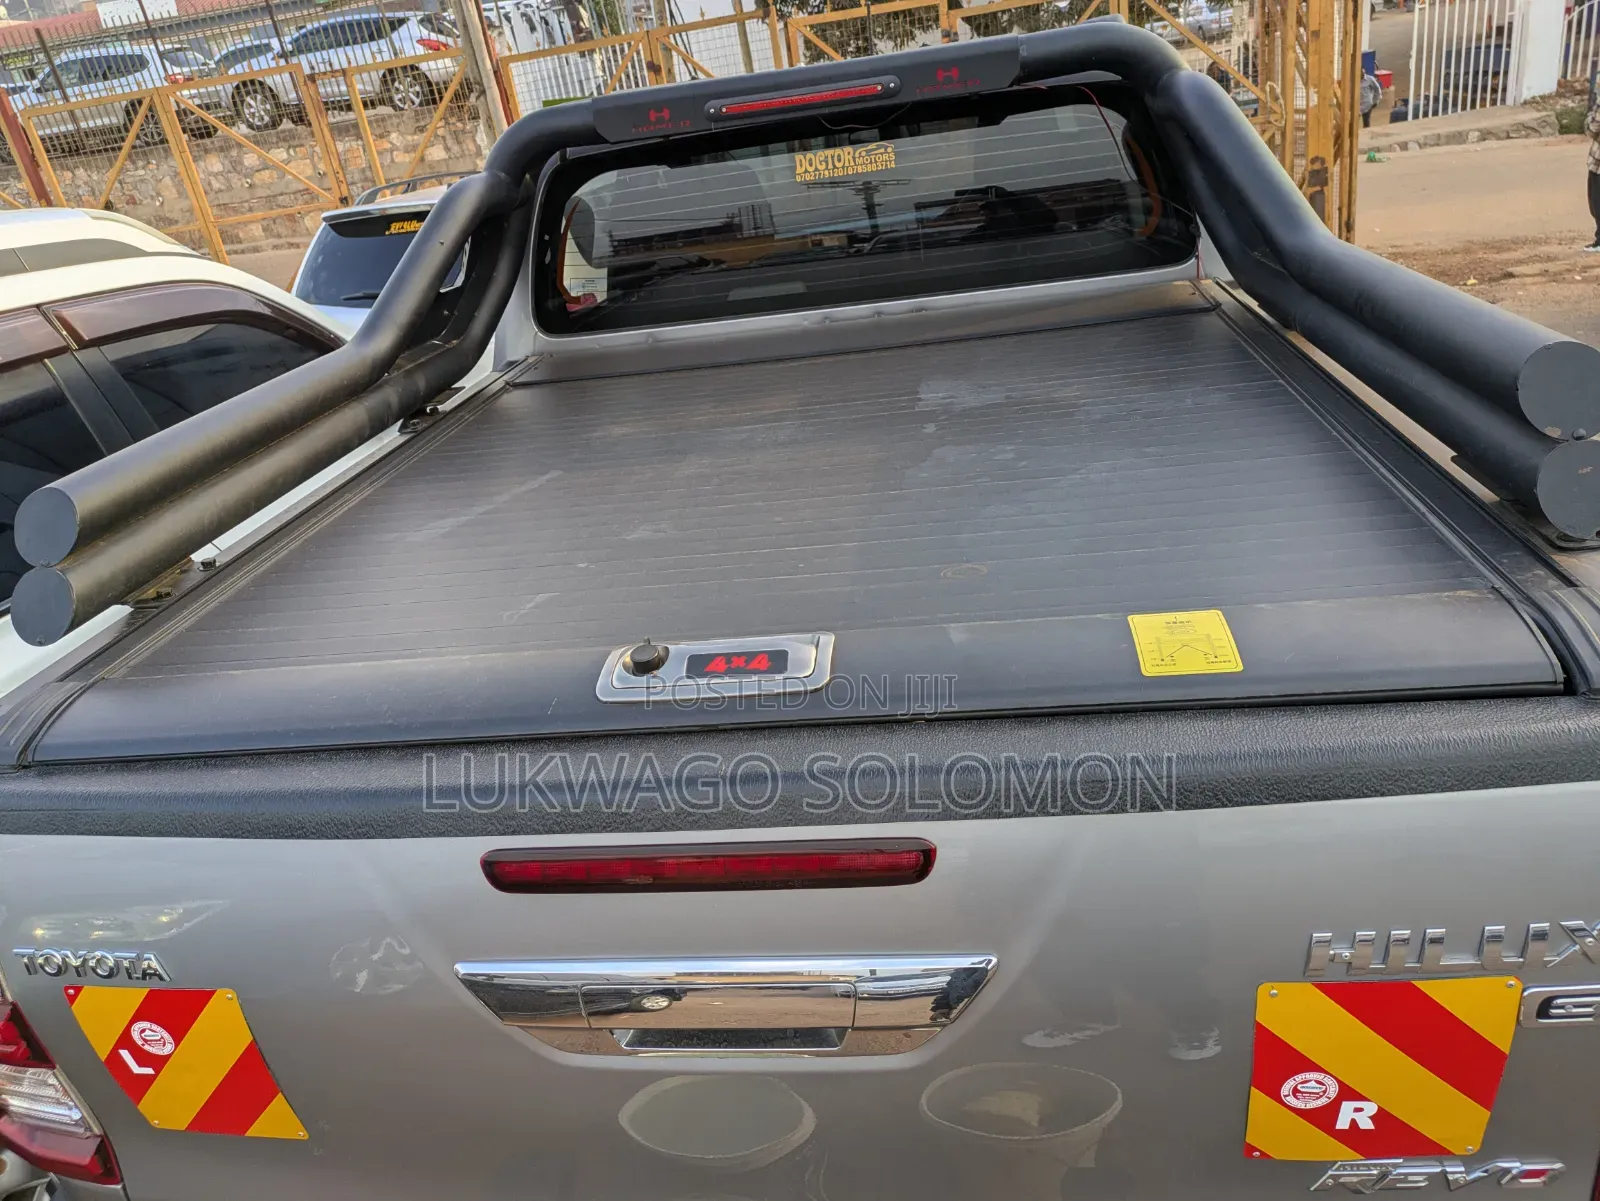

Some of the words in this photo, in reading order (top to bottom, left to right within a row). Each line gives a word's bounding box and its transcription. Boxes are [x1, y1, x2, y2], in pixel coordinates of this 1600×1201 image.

[795, 147, 855, 174] DOCTOR
[855, 152, 896, 166] MOTORS
[12, 947, 172, 982] TOYOTA
[1304, 920, 1600, 977] HILUX
[118, 1049, 155, 1075] L
[1335, 1101, 1378, 1130] R
[1309, 1158, 1566, 1195] REVO
